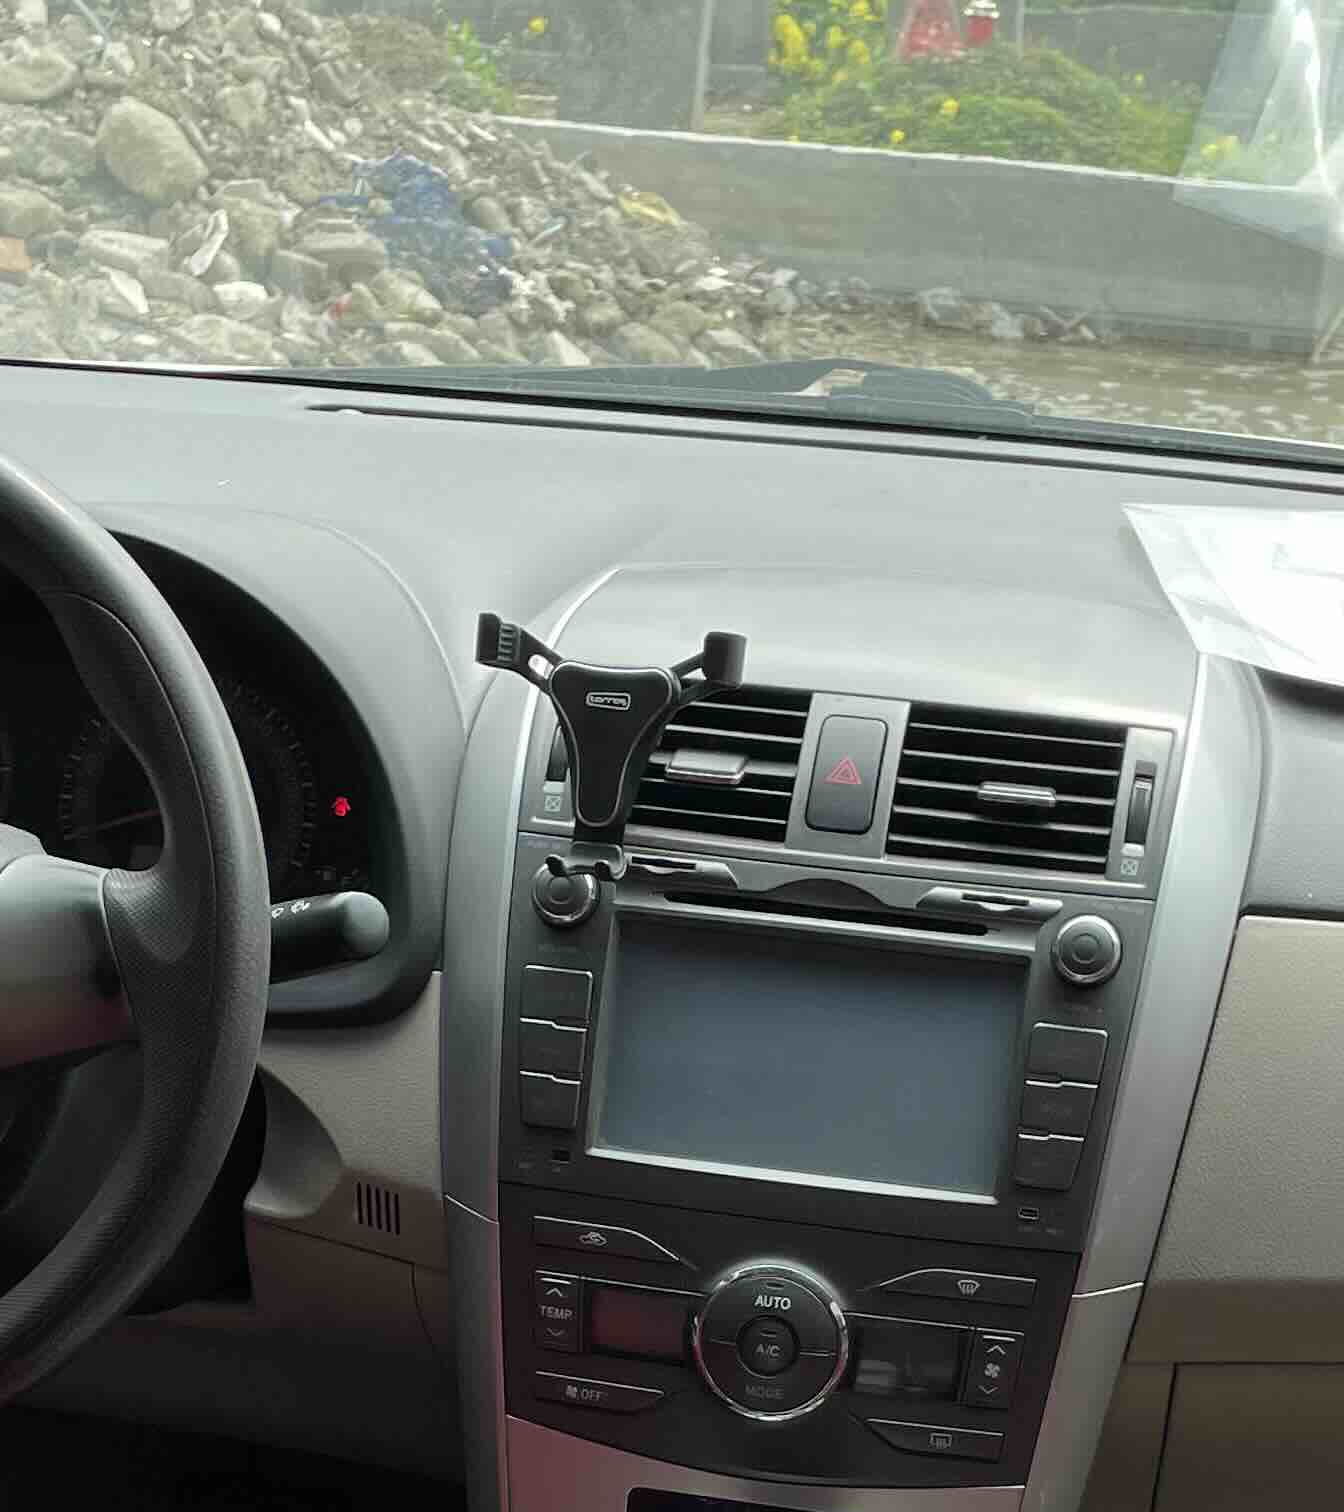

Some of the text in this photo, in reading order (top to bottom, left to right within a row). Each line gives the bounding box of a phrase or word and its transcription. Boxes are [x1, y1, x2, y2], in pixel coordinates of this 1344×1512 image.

[754, 1294, 791, 1310] AUTO
[756, 1343, 781, 1357] A/C
[580, 1386, 605, 1401] OFF
